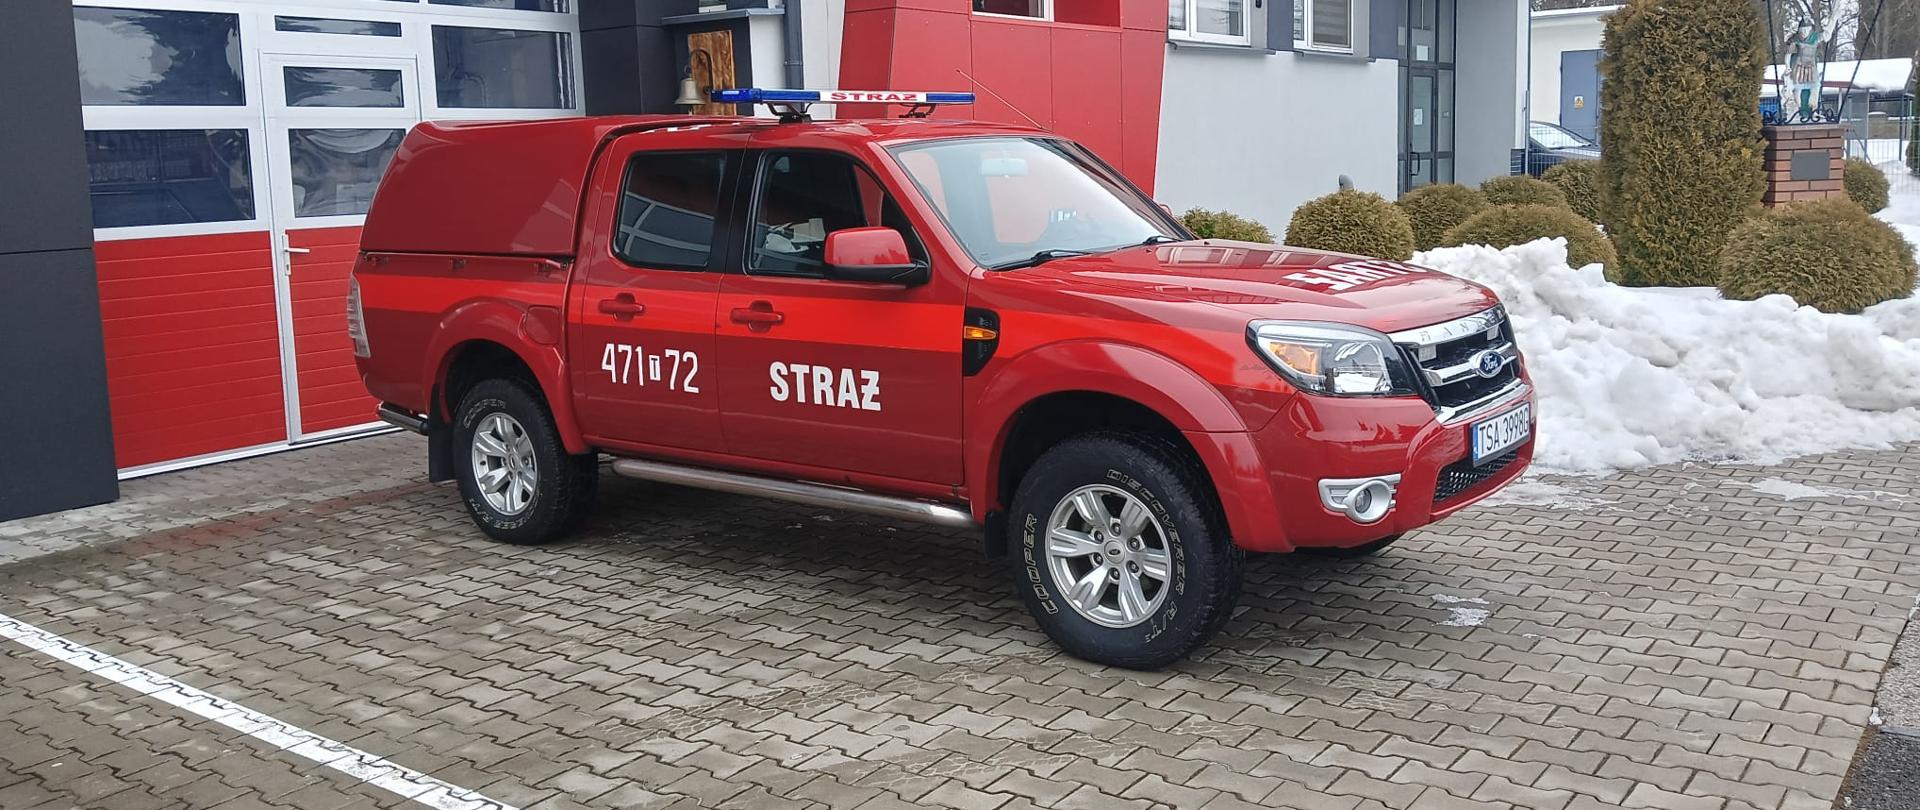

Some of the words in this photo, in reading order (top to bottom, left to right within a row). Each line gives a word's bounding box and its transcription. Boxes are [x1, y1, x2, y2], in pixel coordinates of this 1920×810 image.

[1479, 421, 1501, 455] TSA
[1502, 407, 1529, 444] 3998G
[1023, 513, 1059, 615] COOPER
[1104, 469, 1187, 596] DISCOVERER
